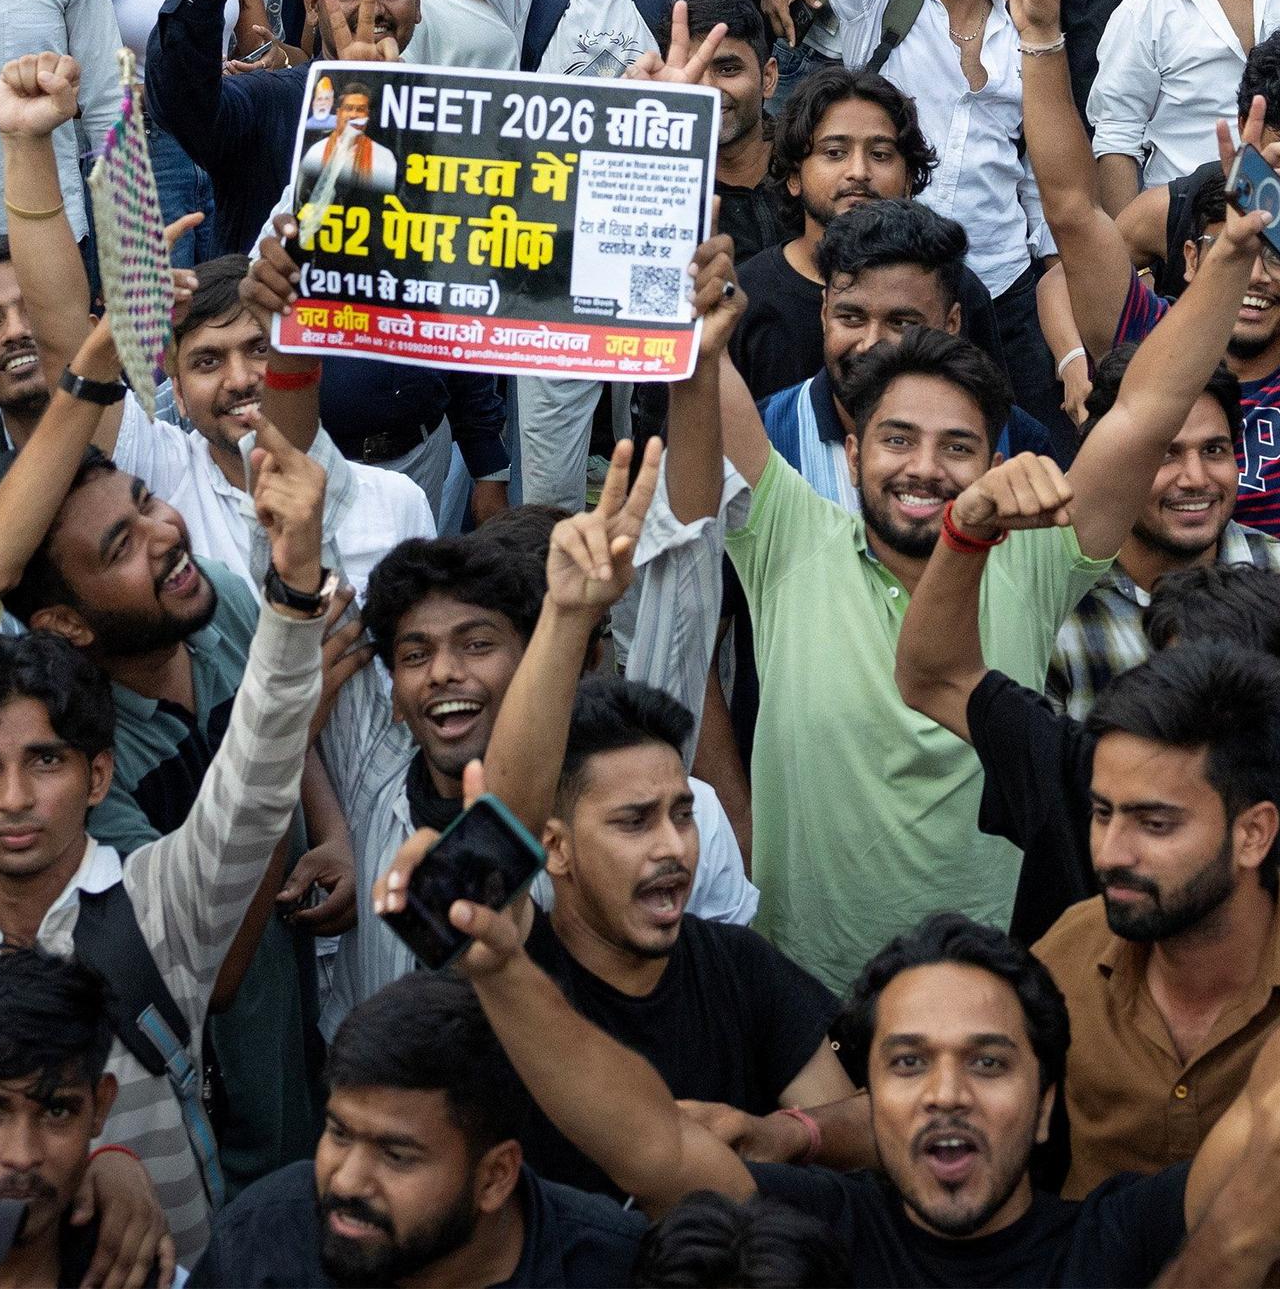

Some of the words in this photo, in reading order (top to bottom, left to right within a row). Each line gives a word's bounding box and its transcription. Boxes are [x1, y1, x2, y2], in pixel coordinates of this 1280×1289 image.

[380, 83, 492, 136] NEET
[500, 93, 596, 144] 2026
[606, 98, 698, 151] सहित
[406, 153, 522, 198] भारत
[531, 151, 578, 201] में
[382, 194, 461, 264] पेपर
[467, 204, 558, 271] लीक
[299, 262, 374, 298] (2014
[377, 269, 399, 301] से
[402, 279, 446, 306] अब
[449, 278, 500, 316] तक)
[296, 306, 330, 329] जय
[333, 304, 370, 333] भीम
[377, 313, 416, 337] बच्चे
[419, 319, 486, 344] बचाओ
[489, 324, 591, 352] आन्दोलन
[605, 334, 641, 357] जय
[643, 336, 678, 365] बापू
